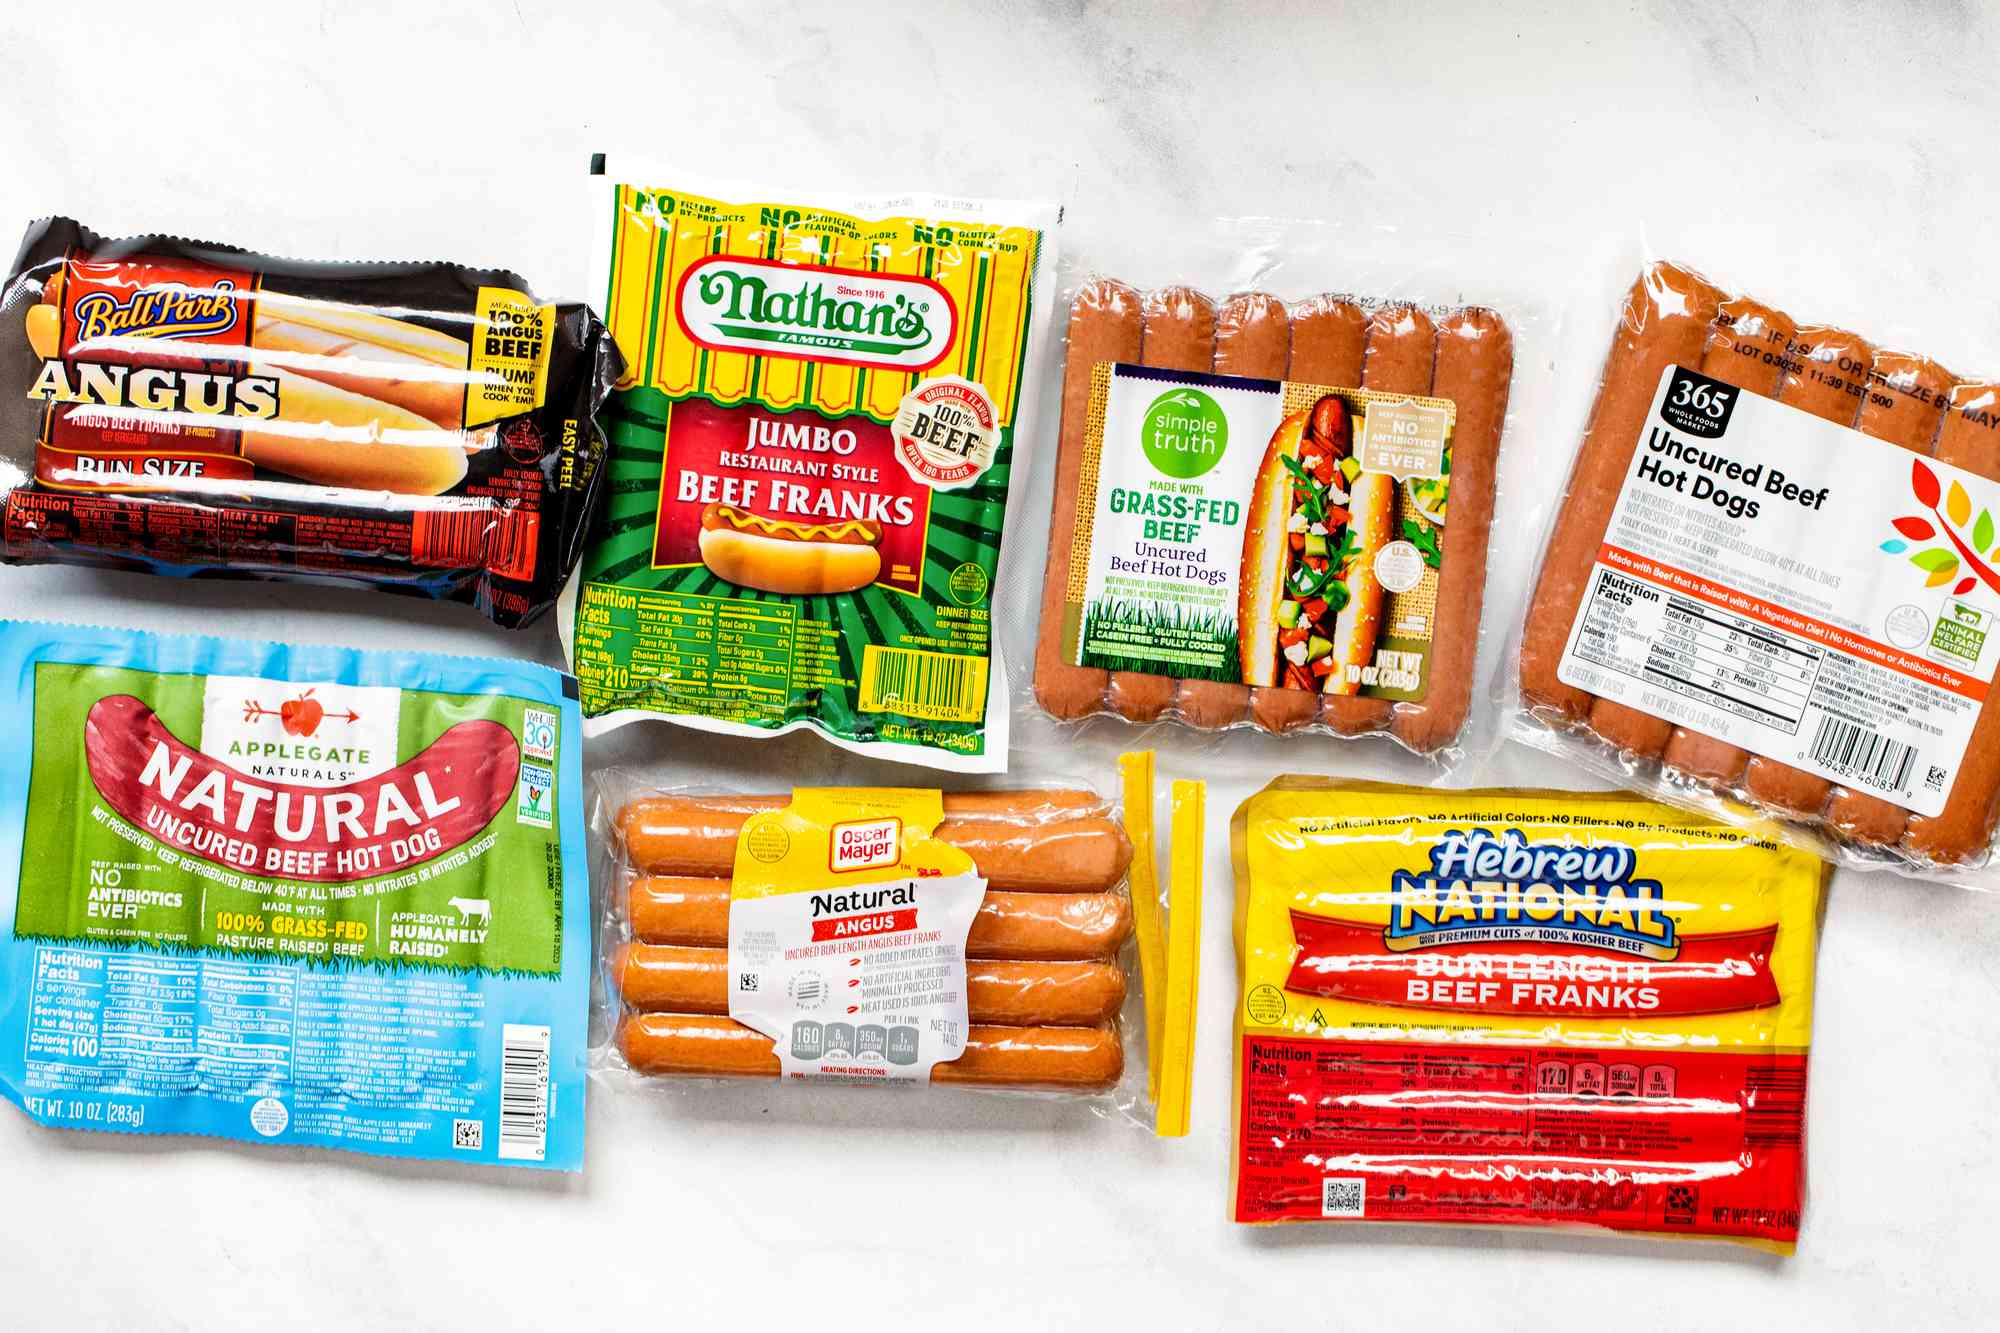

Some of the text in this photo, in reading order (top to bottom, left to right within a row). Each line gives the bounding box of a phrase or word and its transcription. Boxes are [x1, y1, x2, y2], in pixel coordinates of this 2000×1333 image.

[760, 207, 800, 230] NO
[804, 222, 846, 239] FLAVORS
[913, 224, 954, 246] NO
[836, 286, 885, 300] Since 1916
[81, 282, 231, 337] Ball Park
[489, 310, 543, 327] 100%
[487, 327, 543, 340] ANGUS
[777, 333, 854, 350] FAMOUS
[485, 339, 542, 359] BEEF
[1767, 329, 1864, 378] IF OR
[1734, 342, 1893, 410] LOT Q3035 11:39 EST 500
[27, 360, 277, 420] ANGUS
[1672, 379, 1730, 418] 365
[925, 387, 989, 424] ORIGINAL FLAVOR
[934, 404, 974, 426] 100%
[1156, 413, 1217, 433] simple
[1392, 421, 1418, 435] NO
[1668, 406, 1719, 430] WHOLE FOODS
[1676, 417, 1706, 432] MARKET
[747, 416, 857, 456] JUMBO
[911, 412, 979, 457] BEEF
[1154, 430, 1216, 455] truth
[560, 419, 577, 489] EASY PEEL
[906, 444, 969, 479] OVER 100 YEARS
[1378, 452, 1425, 470] EVER
[720, 451, 879, 483] RESTAURANT STYLE
[1648, 426, 1829, 511] Uncured Beef
[677, 469, 914, 526] BEEF FRANKS
[1150, 480, 1203, 495] MADE WITH
[1637, 455, 1760, 519] Hot Dogs
[11, 494, 69, 511] Nutrition
[1110, 487, 1240, 526] GRASS-FED
[9, 508, 45, 522] Facts
[1143, 517, 1200, 544] BEEF
[1135, 542, 1206, 562] Uncured
[1110, 556, 1227, 585] Beef Hot Dogs
[1597, 585, 1633, 606] Facts
[1602, 572, 1660, 602] Nutrition
[582, 585, 636, 625] Nutrition Facts
[936, 606, 988, 620] DINNER SIZE
[1664, 608, 1681, 621] Total
[1607, 550, 1962, 688] Made with Beef that is Raised with: A Vegetarian Diet No Hormones or Antibiotics Ever
[1935, 628, 1981, 651] WELFARE
[1939, 621, 1984, 643] ANIMAL
[1932, 638, 1978, 661] CERTIFIED
[1377, 649, 1423, 673] NET WT
[605, 667, 628, 689] 210
[1345, 665, 1379, 686] 10 OZ
[525, 722, 553, 748] 30
[229, 741, 370, 764] APPLEGATE
[1818, 758, 1894, 792] 99482 46083
[146, 804, 442, 876] UNCURED BEEF HOT DOG
[842, 826, 892, 844] Oscar
[90, 805, 468, 900] NOT PRESERVED KEEP REFRIGERATED BELOW AT ALL TIMES NO NITRATES OR NITRITES
[839, 841, 892, 863] Mayer
[1437, 832, 1629, 883] Hebrew
[90, 869, 121, 886] NO
[88, 887, 183, 907] ANTIBIOTICS
[810, 882, 916, 917] Natural
[1400, 877, 1665, 939] NATIONAL
[87, 903, 138, 919] EVER
[262, 902, 325, 916] MADE WITH
[392, 911, 455, 926] APPLEGATE
[216, 912, 368, 941] 100% GRASS-FED
[390, 924, 489, 944] HUMANELY
[833, 914, 895, 936] ANGUS
[216, 934, 365, 956] PASTURE BEEF
[784, 930, 942, 960] UNCURED BUN-LENGTH ANGUS BEEF FRANKS
[1439, 929, 1491, 942] PREMIUM
[1494, 928, 1521, 939] CUTS
[1538, 929, 1569, 941] 100%
[1572, 933, 1615, 947] KOSHER
[1618, 939, 1645, 953] BEEF
[40, 951, 103, 969] Nutrition
[864, 947, 934, 965] NO ADDED NITRATES
[38, 965, 80, 980] Facts
[862, 971, 913, 986] NO ARTIFICIAL
[1416, 957, 1651, 984] BUN LENGTH
[862, 979, 943, 999] MINIMALLY PROCESSED
[1407, 979, 1660, 1010] BEEF FRANKS
[34, 1006, 94, 1021] Serving size
[797, 1026, 819, 1044] 160
[930, 1019, 947, 1032] NET
[31, 1033, 98, 1057] Calories 100
[1252, 1045, 1311, 1062] Nutrition
[1251, 1061, 1287, 1076] Facts
[1541, 1068, 1566, 1086] 170
[24, 1095, 144, 1127] NET WT. 10 OZ. (283g)
